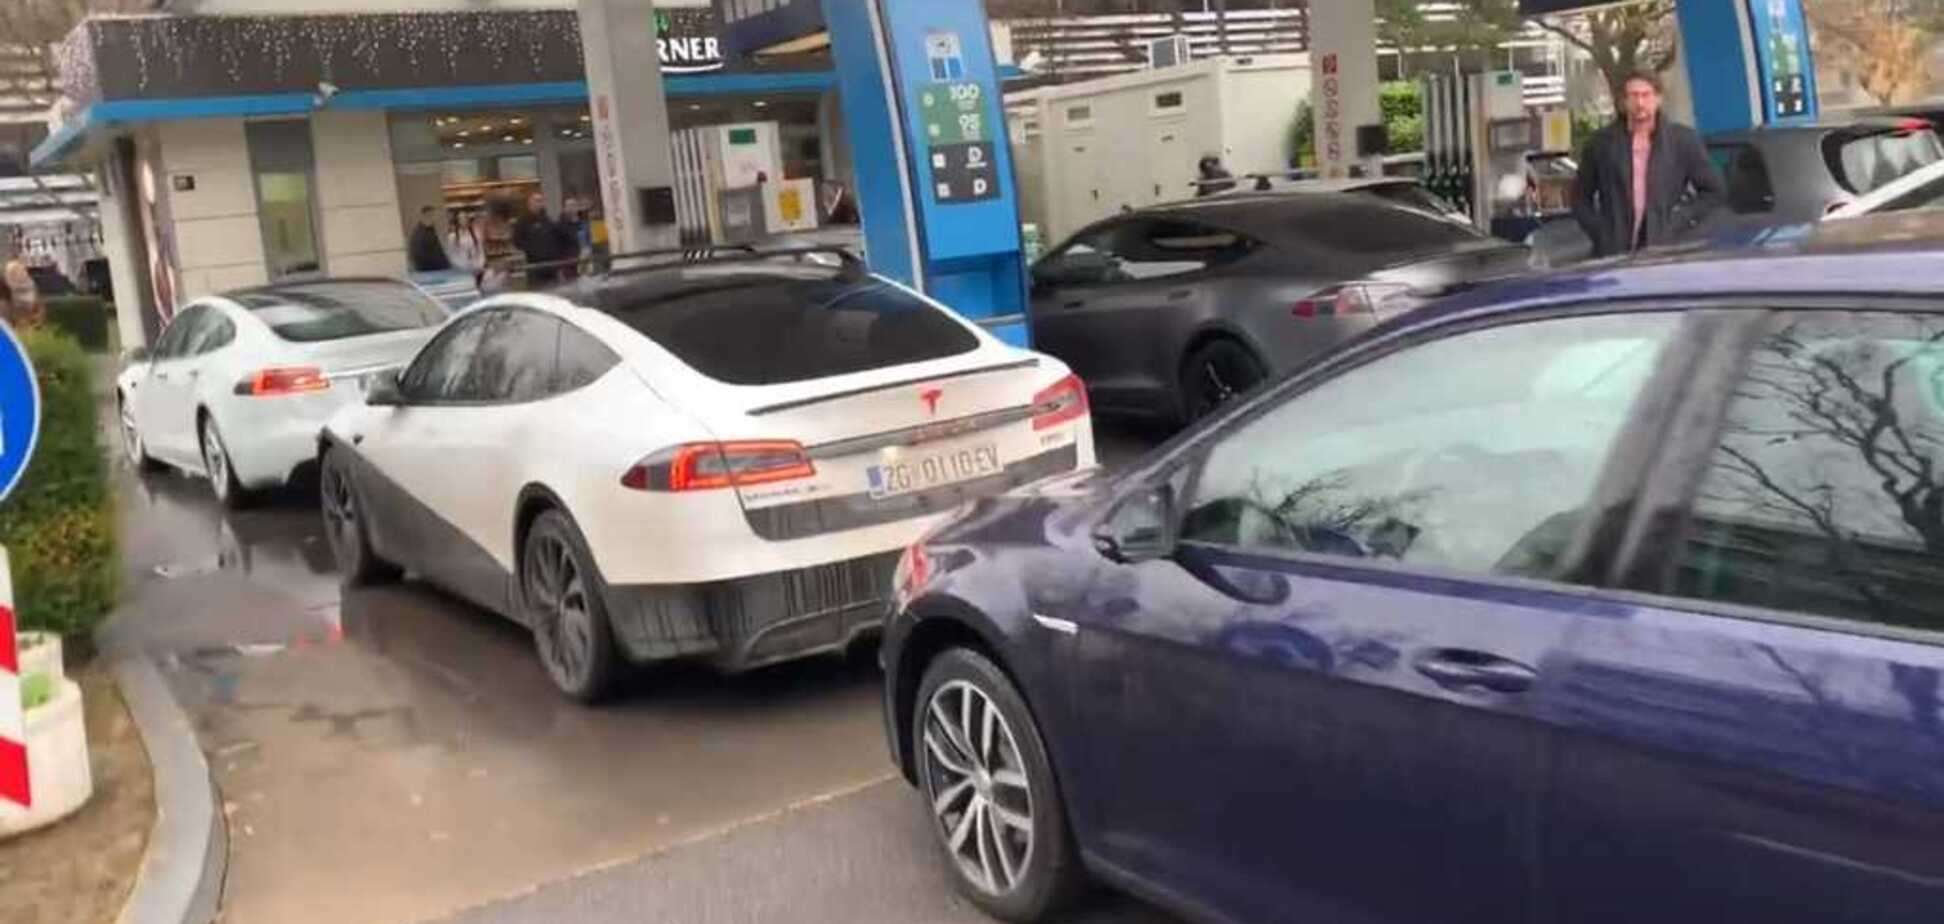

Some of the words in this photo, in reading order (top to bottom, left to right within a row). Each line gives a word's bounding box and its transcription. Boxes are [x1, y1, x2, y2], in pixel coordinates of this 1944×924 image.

[949, 84, 980, 100] 100
[968, 146, 982, 163] D
[974, 178, 987, 195] D
[882, 463, 911, 492] ZG
